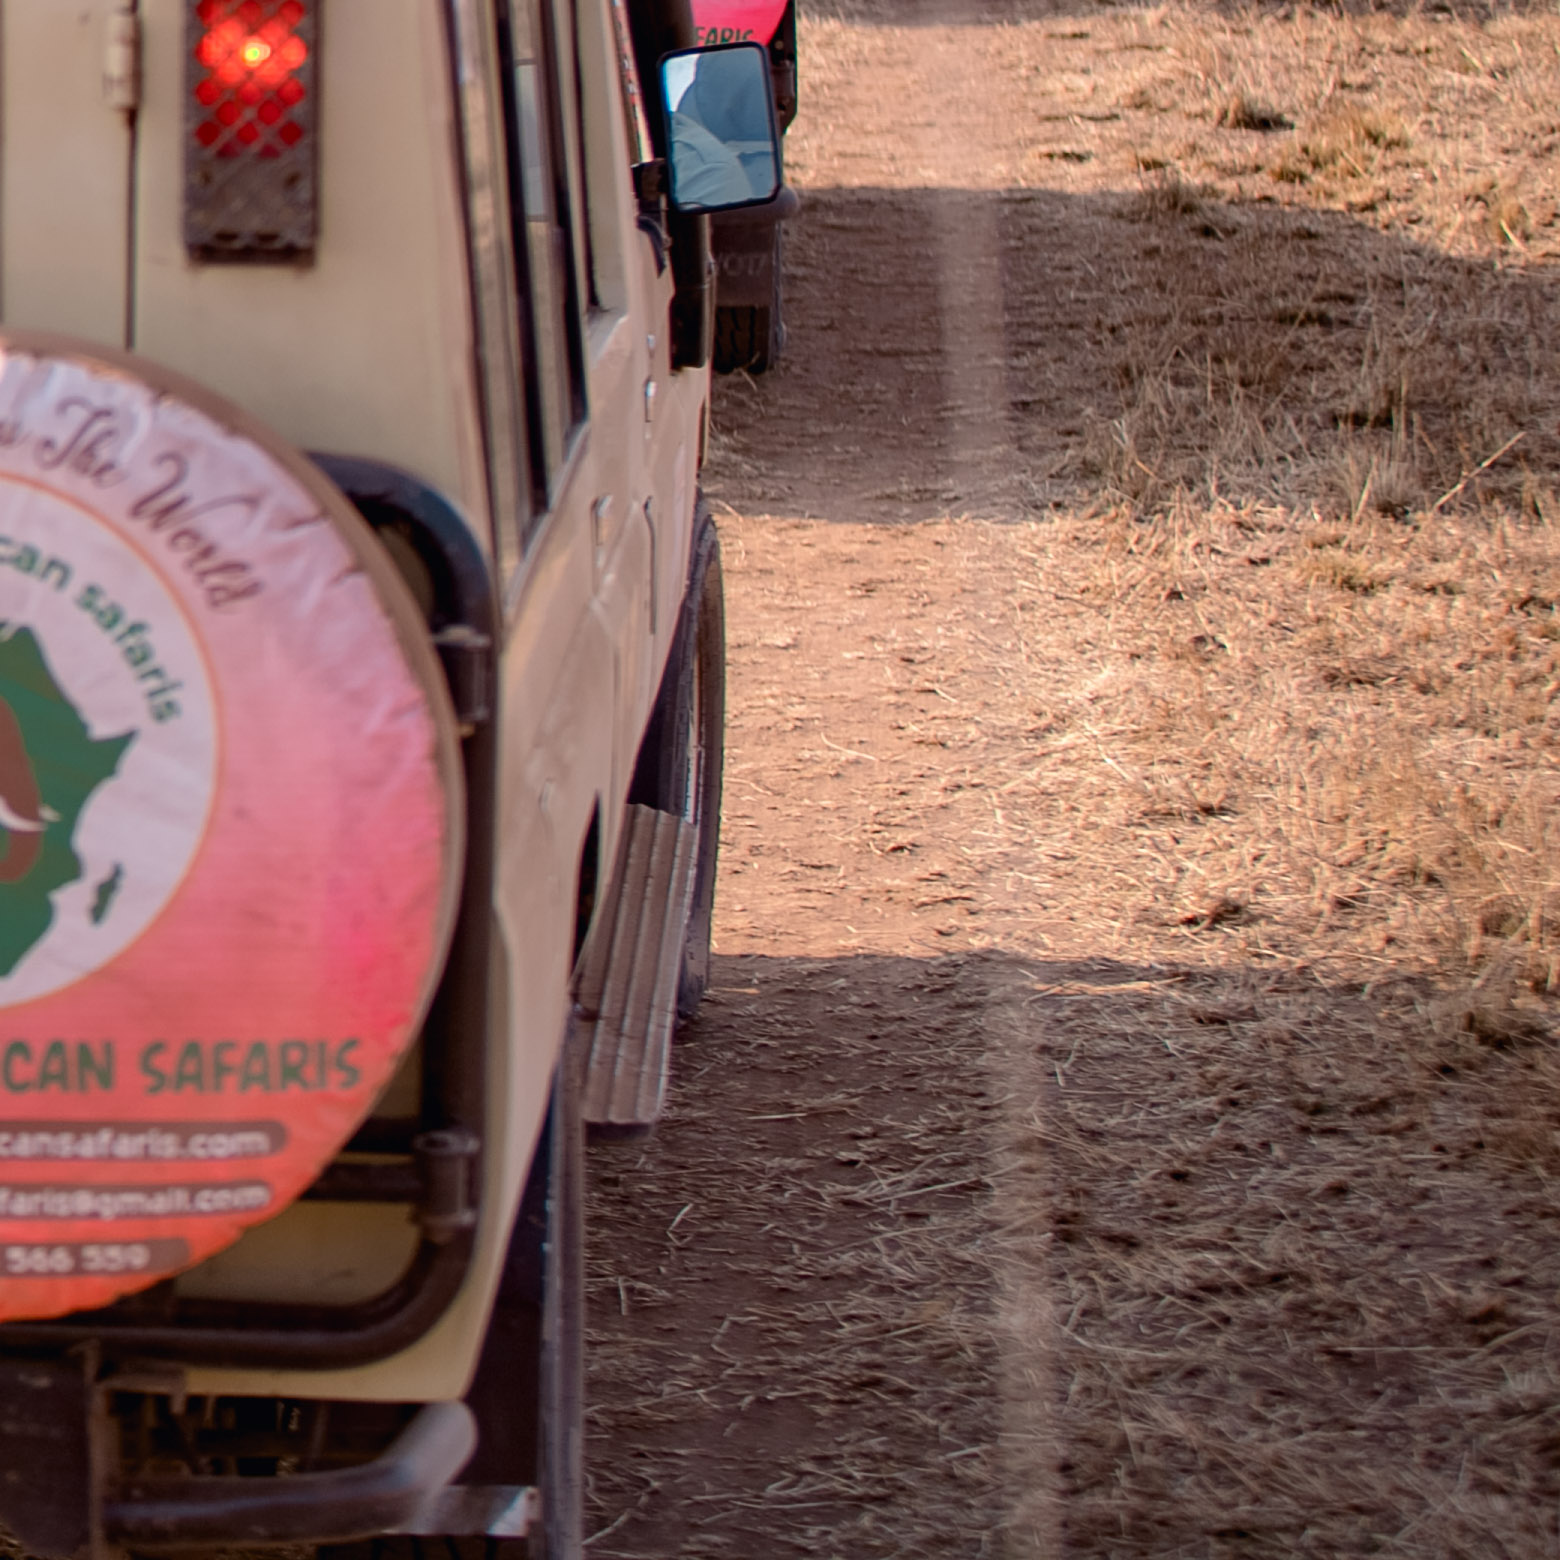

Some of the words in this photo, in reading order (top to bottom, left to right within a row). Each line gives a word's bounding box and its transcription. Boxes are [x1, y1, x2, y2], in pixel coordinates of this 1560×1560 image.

[33, 394, 120, 488] The
[127, 448, 266, 610] World
[74, 583, 183, 725] safaris
[137, 1038, 362, 1096] SAFARIS
